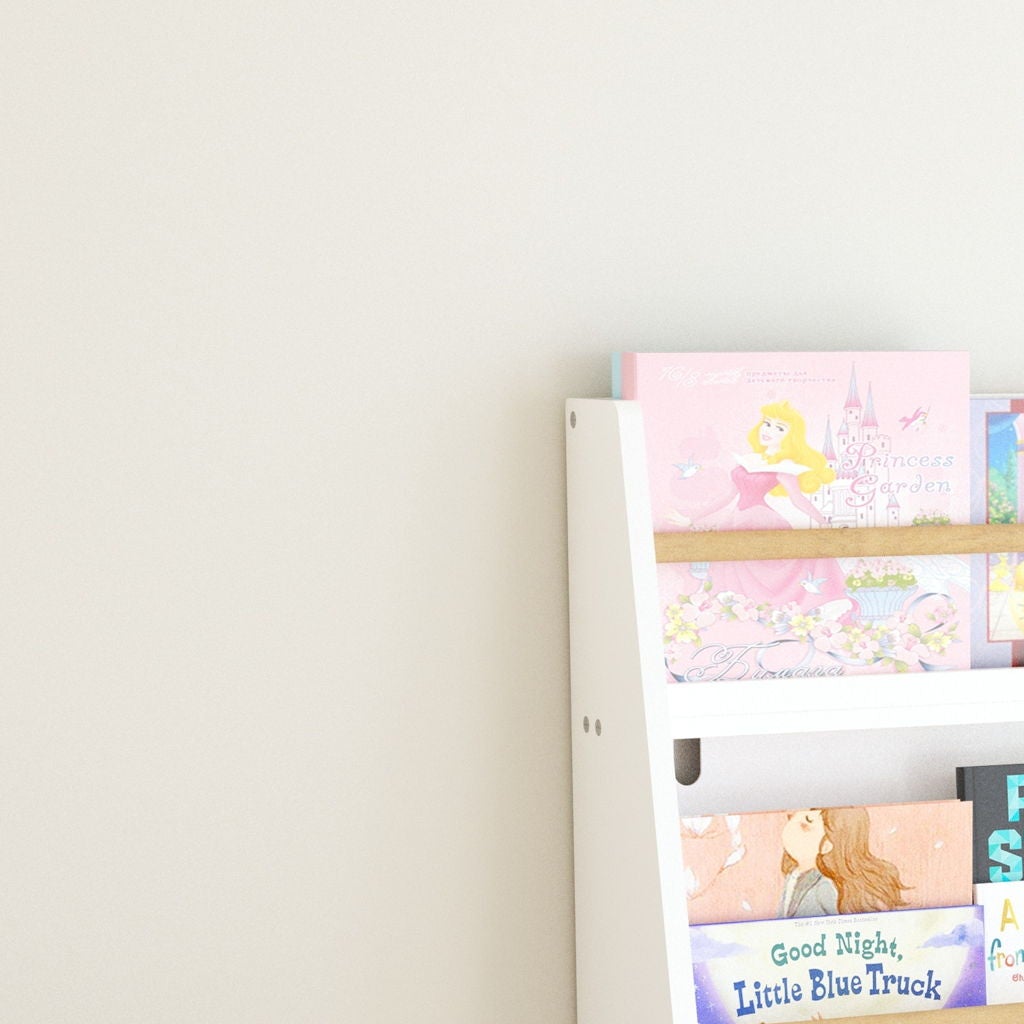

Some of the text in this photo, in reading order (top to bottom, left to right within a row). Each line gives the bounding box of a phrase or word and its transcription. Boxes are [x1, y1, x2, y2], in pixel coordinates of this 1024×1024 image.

[842, 442, 955, 470] Princess
[845, 474, 952, 507] Garden
[1000, 898, 1020, 932] A
[770, 930, 904, 967] Good Night,
[733, 962, 942, 1017] Little Blue Truck
[1011, 972, 1024, 982] on
